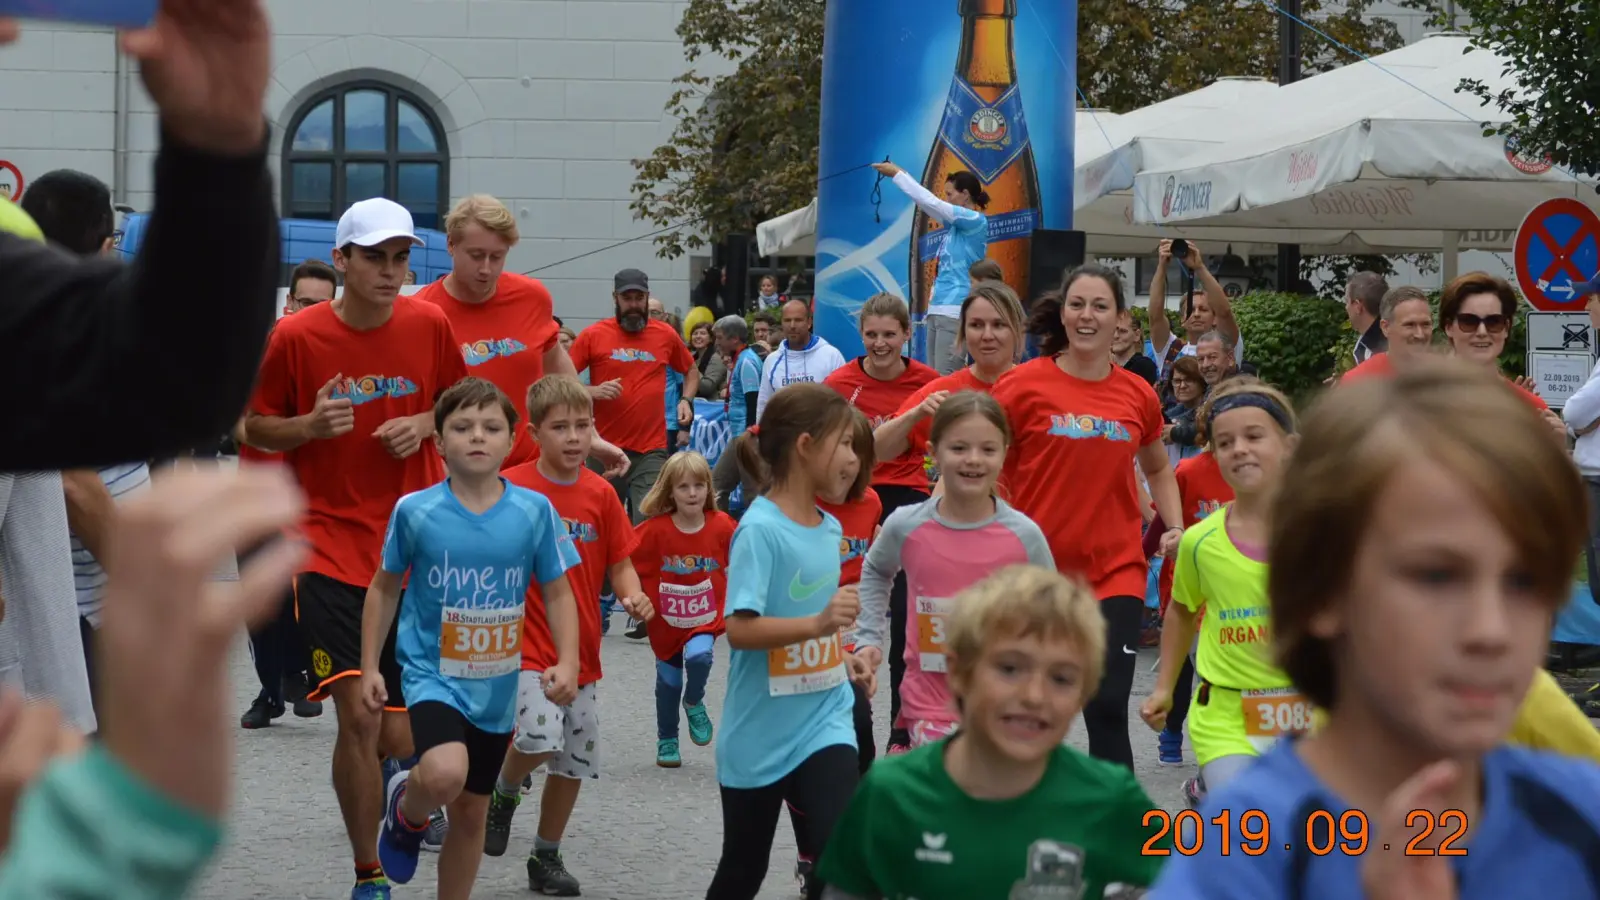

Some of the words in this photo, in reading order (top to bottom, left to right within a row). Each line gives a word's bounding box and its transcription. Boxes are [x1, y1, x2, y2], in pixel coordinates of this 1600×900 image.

[1172, 180, 1213, 215] ERDINGER
[1543, 373, 1580, 382] 22.09.2019
[1548, 384, 1567, 392] 06-23
[1569, 384, 1574, 392] h
[428, 549, 498, 591] ohne
[667, 595, 709, 615] 2164
[454, 624, 518, 653] 3015
[784, 631, 839, 670] 3071
